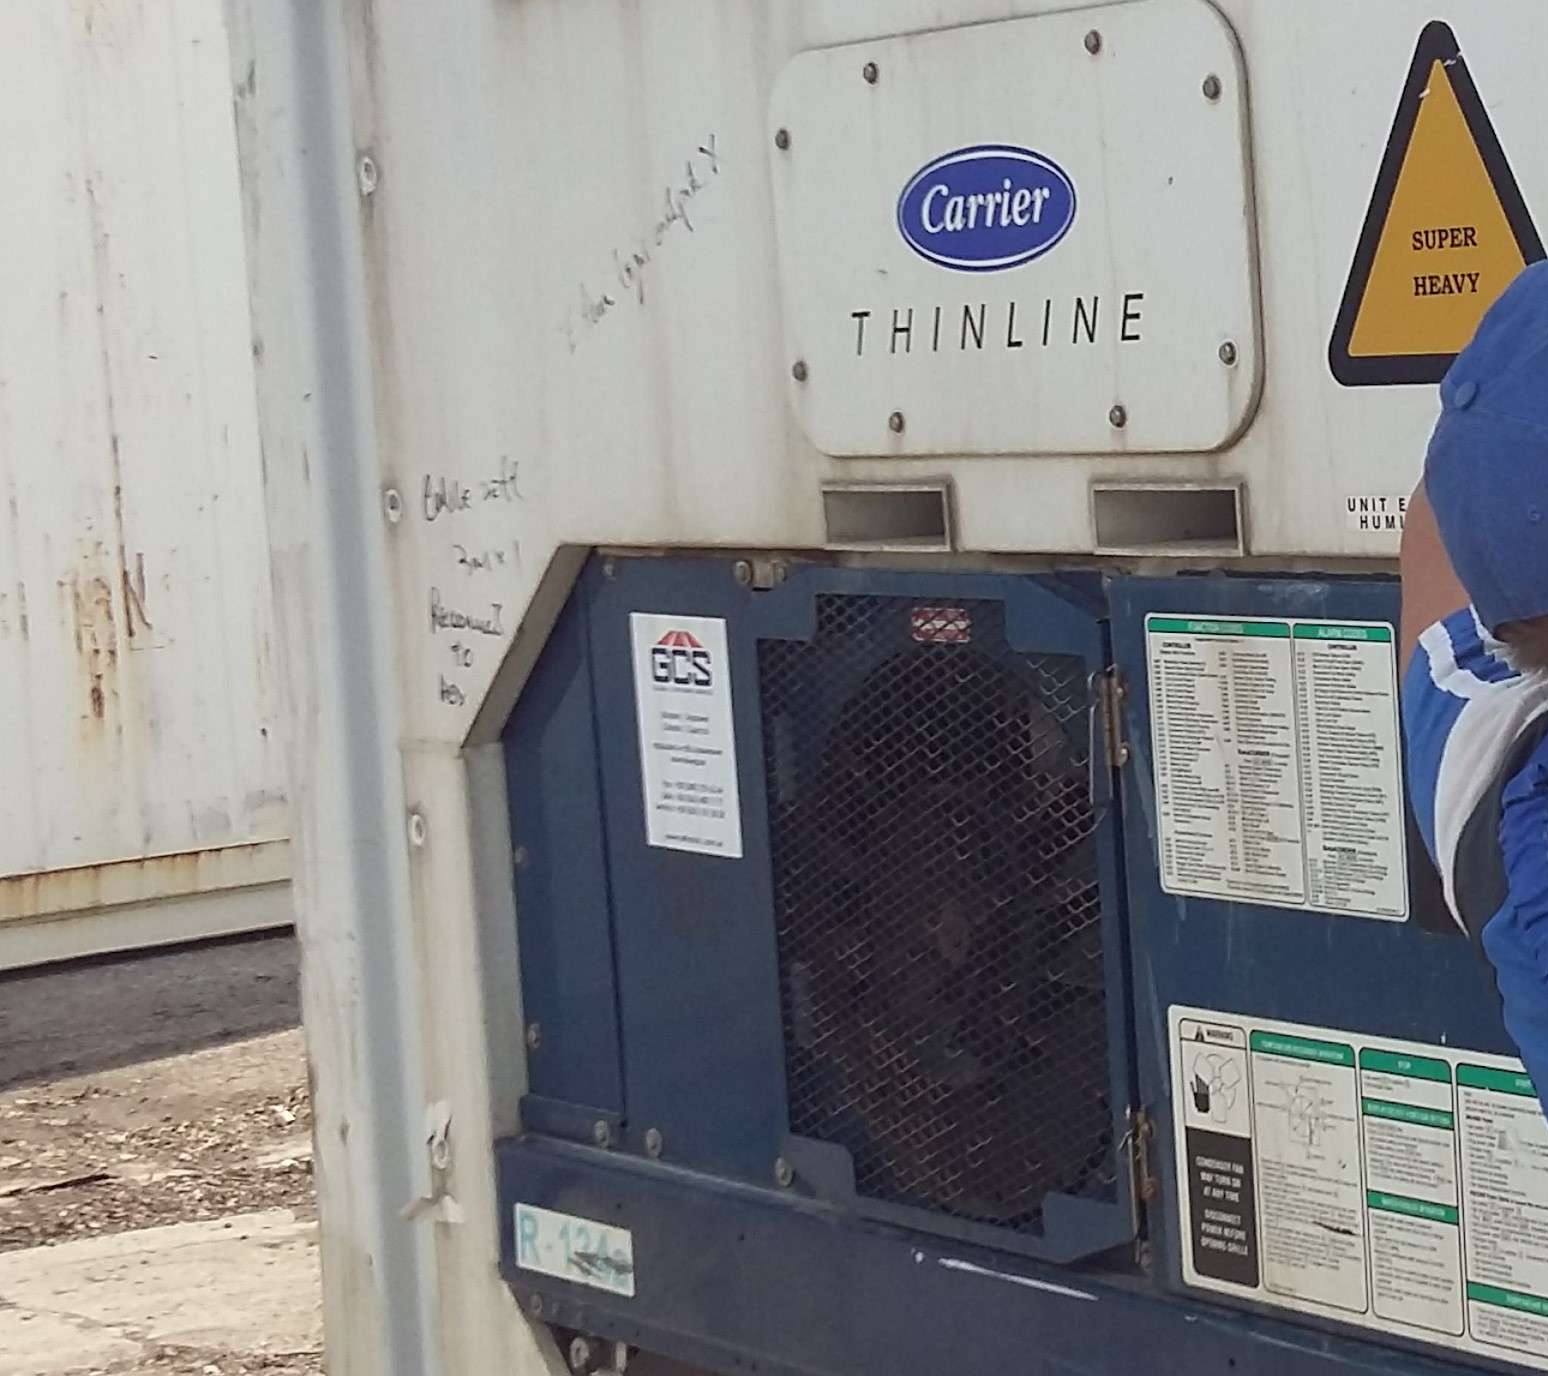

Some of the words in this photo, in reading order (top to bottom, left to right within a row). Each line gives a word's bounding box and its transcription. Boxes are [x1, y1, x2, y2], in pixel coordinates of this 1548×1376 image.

[921, 177, 1051, 235] Carrier
[1412, 226, 1478, 251] SUPER
[1413, 272, 1480, 297] HEAVY
[851, 292, 1144, 356] THINLINE
[1347, 497, 1386, 512] UNIT
